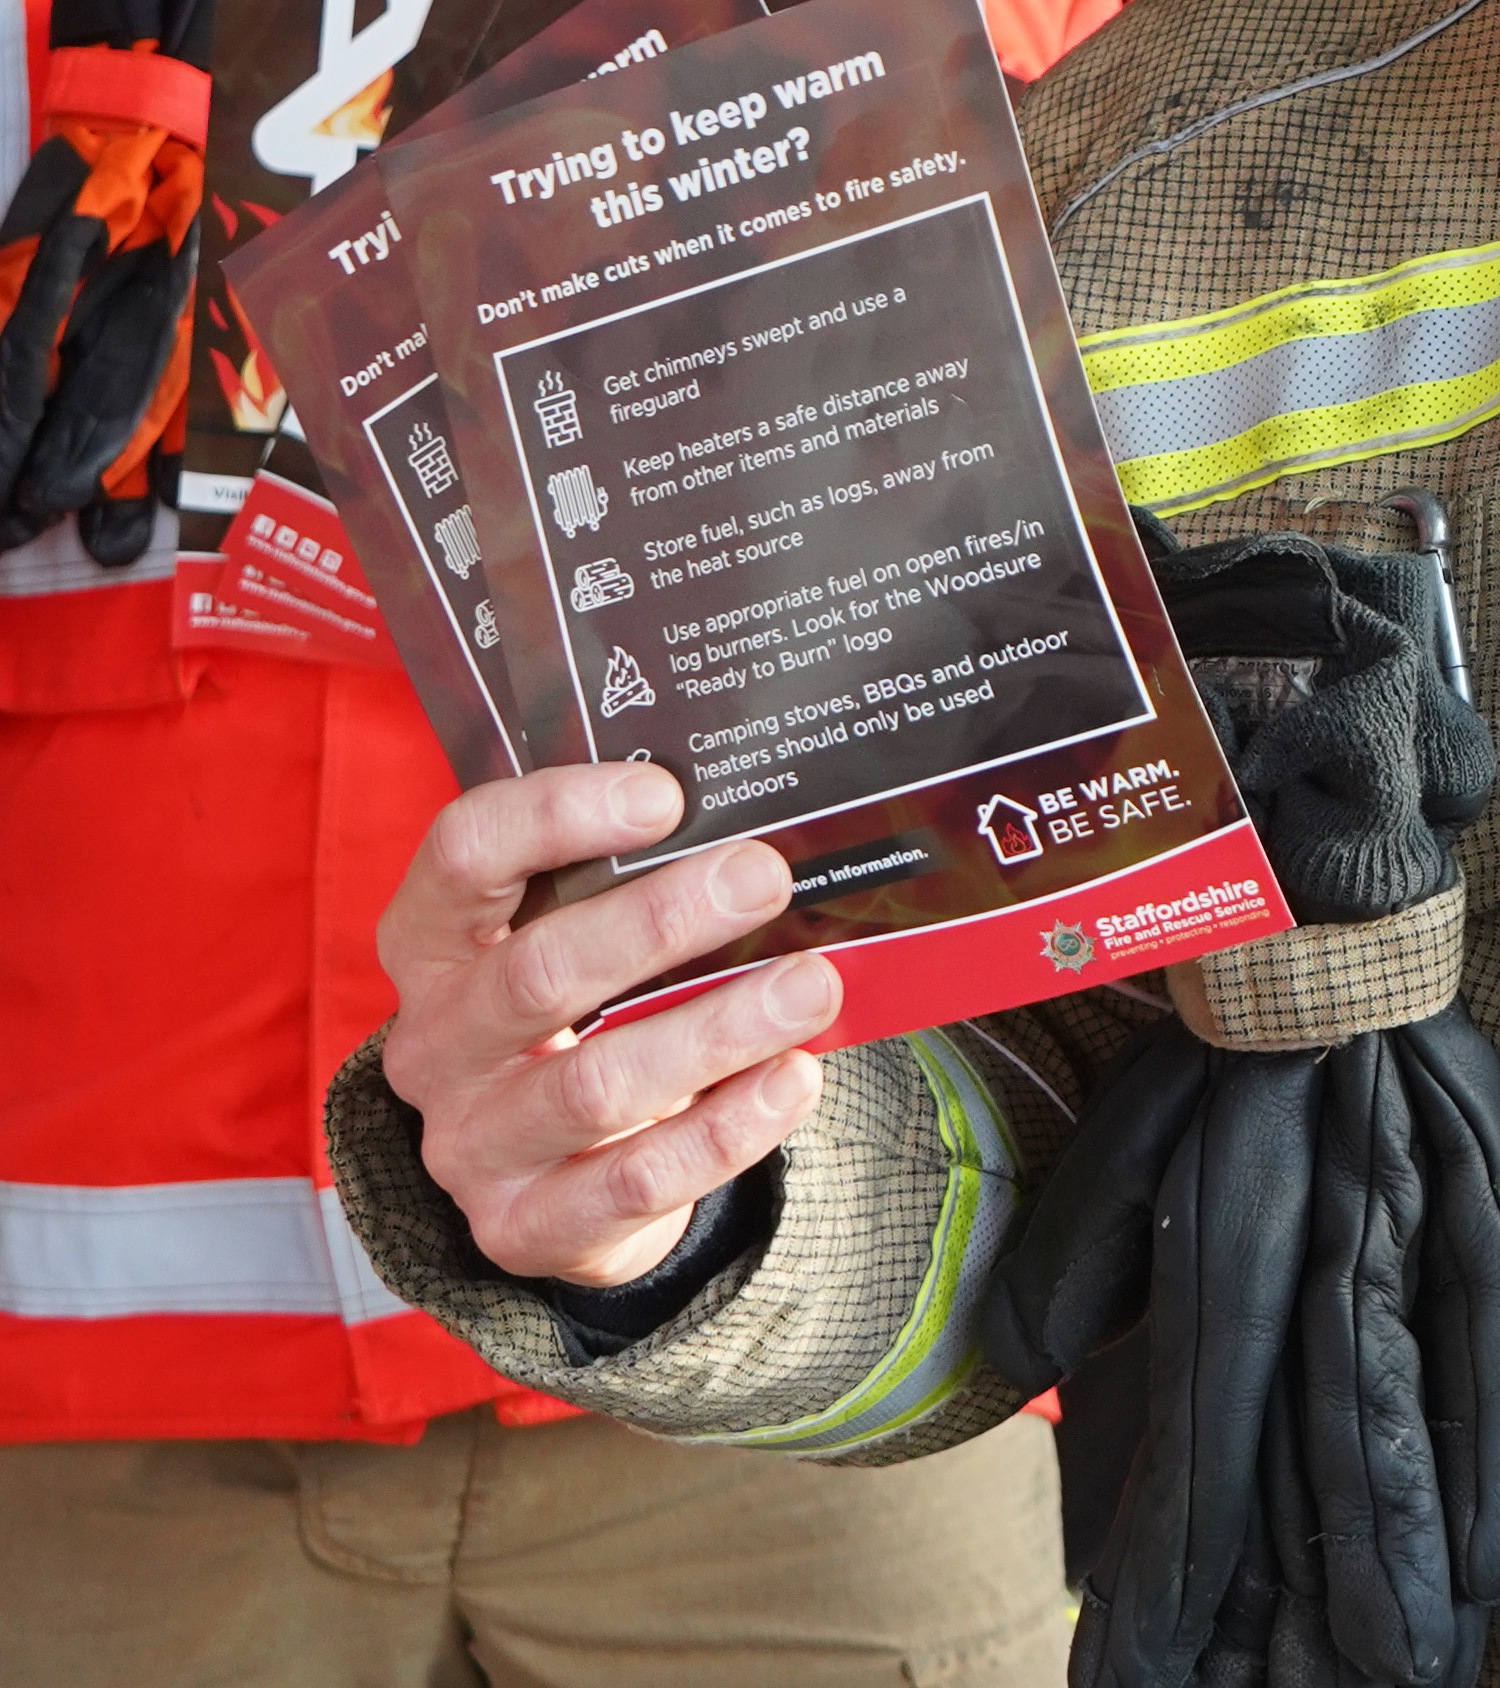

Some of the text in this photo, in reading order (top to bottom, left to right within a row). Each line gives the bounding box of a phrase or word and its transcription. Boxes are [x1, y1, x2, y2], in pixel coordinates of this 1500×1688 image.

[490, 51, 886, 204] Trying to keep warm
[590, 126, 810, 228] this winter?
[328, 210, 403, 276] Tryi
[477, 151, 966, 324] Don't make cuts when it comes to fire safety.
[604, 288, 906, 395] Get chimneys swept and use a
[610, 379, 701, 423] fireguard
[623, 358, 968, 478] Keep heaters a safe distance away
[630, 397, 939, 506] from other items and materials
[644, 443, 994, 561] Store fuel, such as logs, away from
[650, 532, 803, 589] the heat source
[663, 519, 1045, 645] Use appropriate fuel on open fires/in
[670, 553, 1041, 673] log burners. Look for the Woodsure
[676, 627, 892, 699] "Ready to Burn" logo
[689, 630, 1068, 753] Camping stoves, BBQs and outdoor
[694, 679, 995, 782] heaters should only be used
[702, 771, 799, 810] outdoors
[1038, 759, 1180, 814] BE WARM.
[1048, 785, 1191, 844] BE SAFE.
[829, 849, 928, 882] information.
[1097, 879, 1259, 937] Staffordshire
[1104, 897, 1266, 950] Fire and Rescue Service
[1111, 909, 1269, 961] preventing protecting responding
